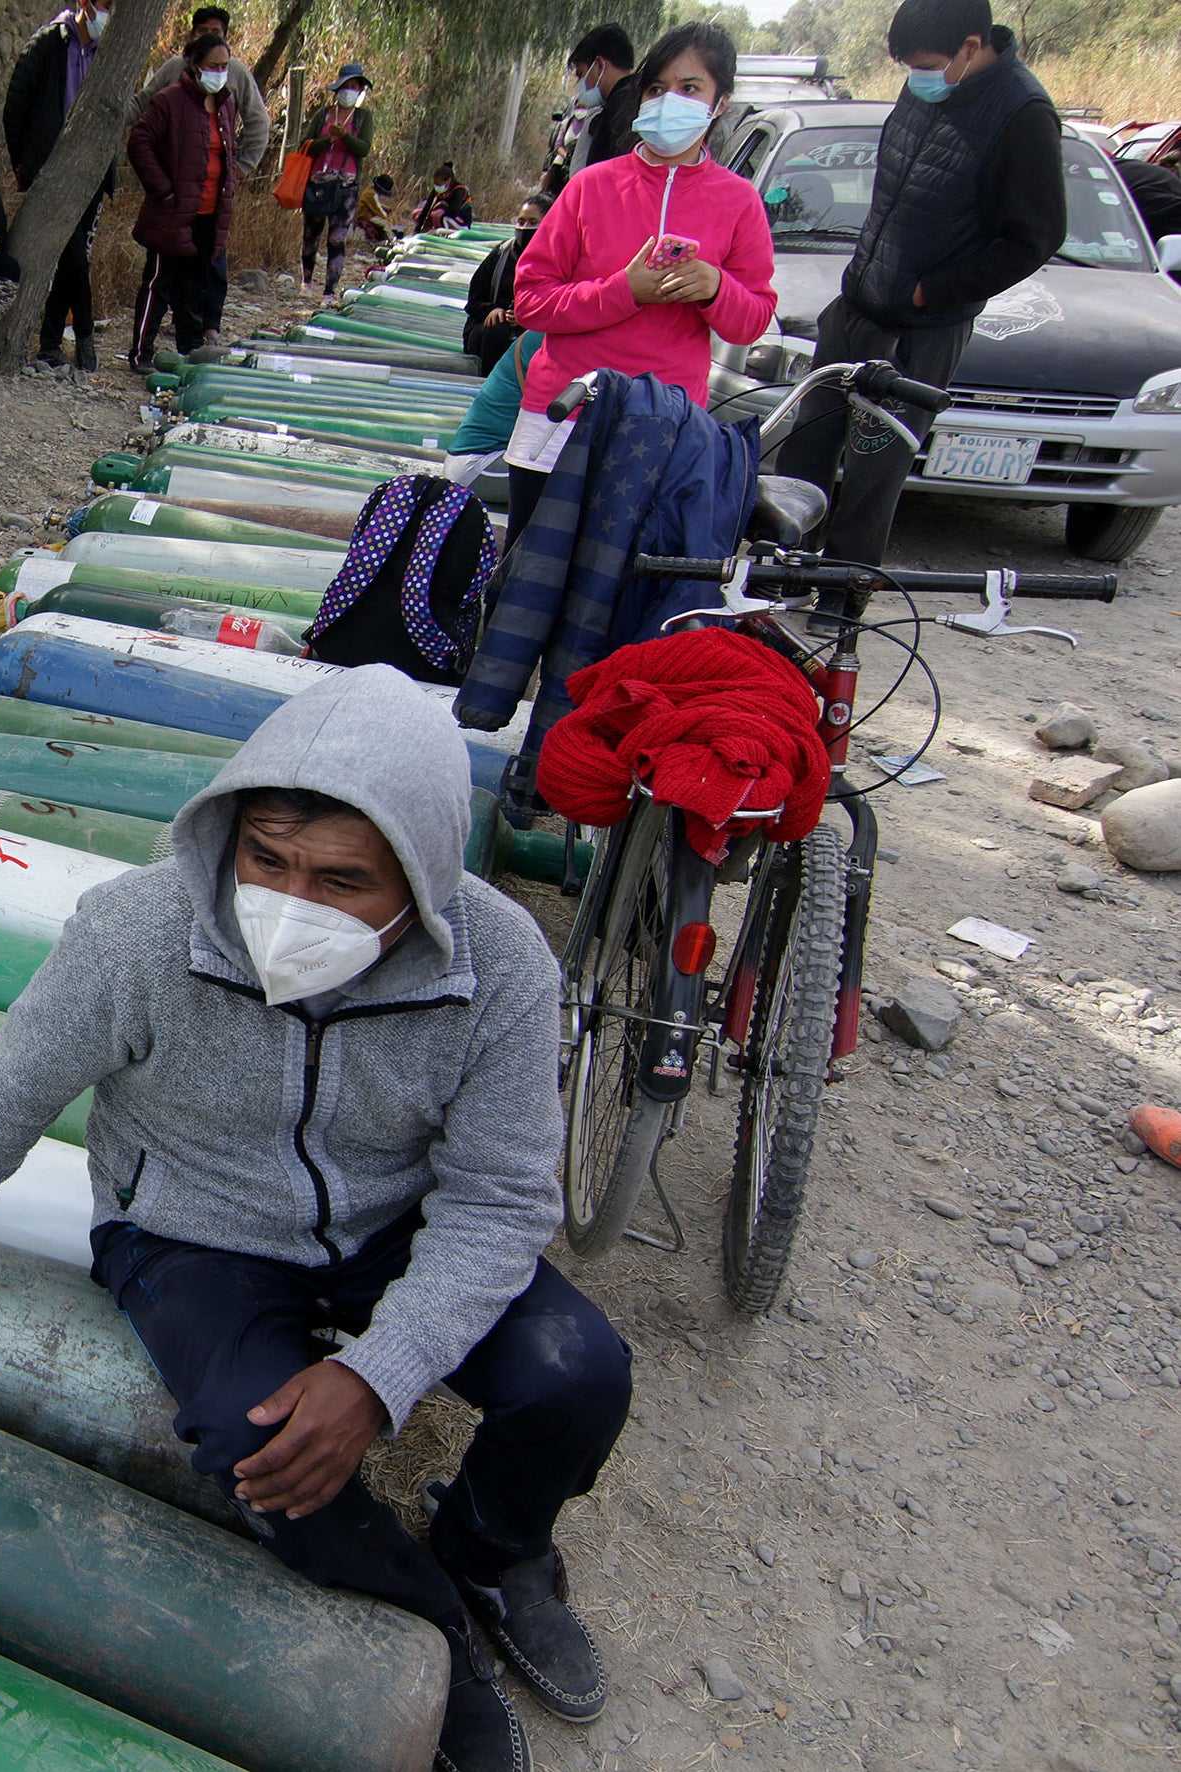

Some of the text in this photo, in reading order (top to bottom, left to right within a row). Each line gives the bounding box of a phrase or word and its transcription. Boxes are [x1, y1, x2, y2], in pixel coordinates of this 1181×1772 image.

[958, 437, 1012, 449] BOLIVIA
[933, 447, 1032, 480] 1576LRY
[297, 960, 328, 976] KN95
